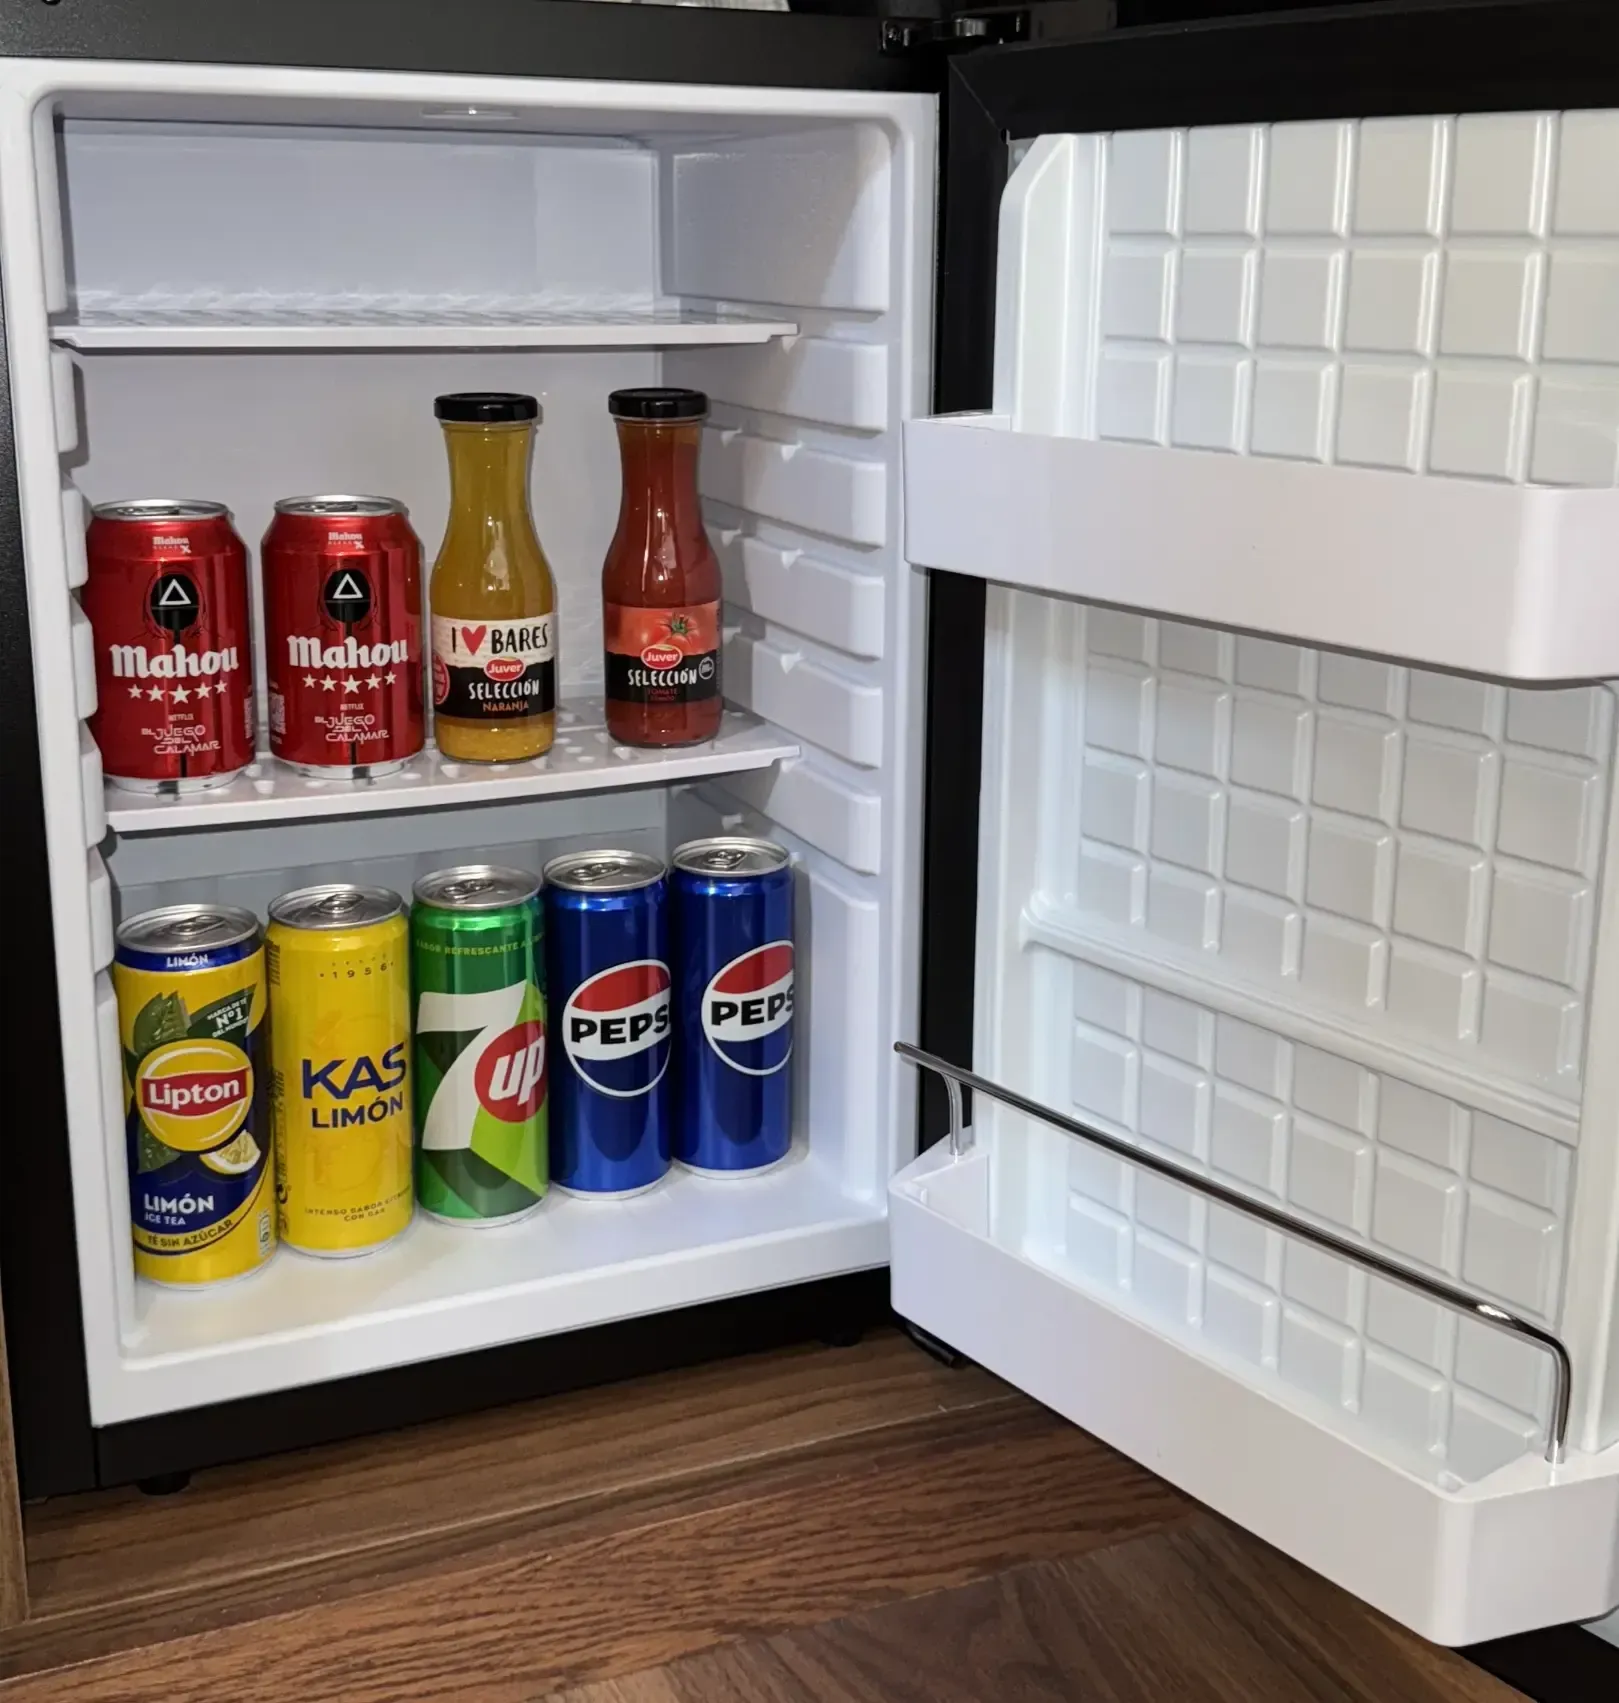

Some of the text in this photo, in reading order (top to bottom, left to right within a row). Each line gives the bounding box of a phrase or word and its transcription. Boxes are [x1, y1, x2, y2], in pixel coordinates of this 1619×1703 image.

[153, 537, 189, 545] Mahou
[328, 532, 363, 541] Mahou
[452, 623, 548, 654] I BARES
[109, 644, 239, 678] Mahou
[286, 635, 409, 669] Mahou
[646, 652, 678, 662] Juver
[488, 663, 522, 674] Juver
[628, 668, 697, 687] SELECCIÓN
[468, 678, 540, 700] SELECCIÓN
[483, 700, 529, 712] NARANJA
[327, 712, 375, 730] JUEGO
[154, 724, 205, 742] JUEGO
[325, 730, 390, 744] CALAMAR
[154, 740, 221, 756] CALAMAR
[444, 942, 519, 956] REFRESCANTE
[166, 953, 208, 968] LIMÓN
[711, 984, 795, 1026] PEPS
[571, 1003, 671, 1045] PEPS
[302, 1041, 407, 1100] KAS
[149, 1079, 240, 1110] Lipton
[312, 1091, 403, 1128] LIMÓN
[144, 1193, 214, 1214] LIMÓN
[145, 1213, 186, 1226] ICE TEA
[147, 1219, 234, 1247] TÉ SIN AZÚCAR
